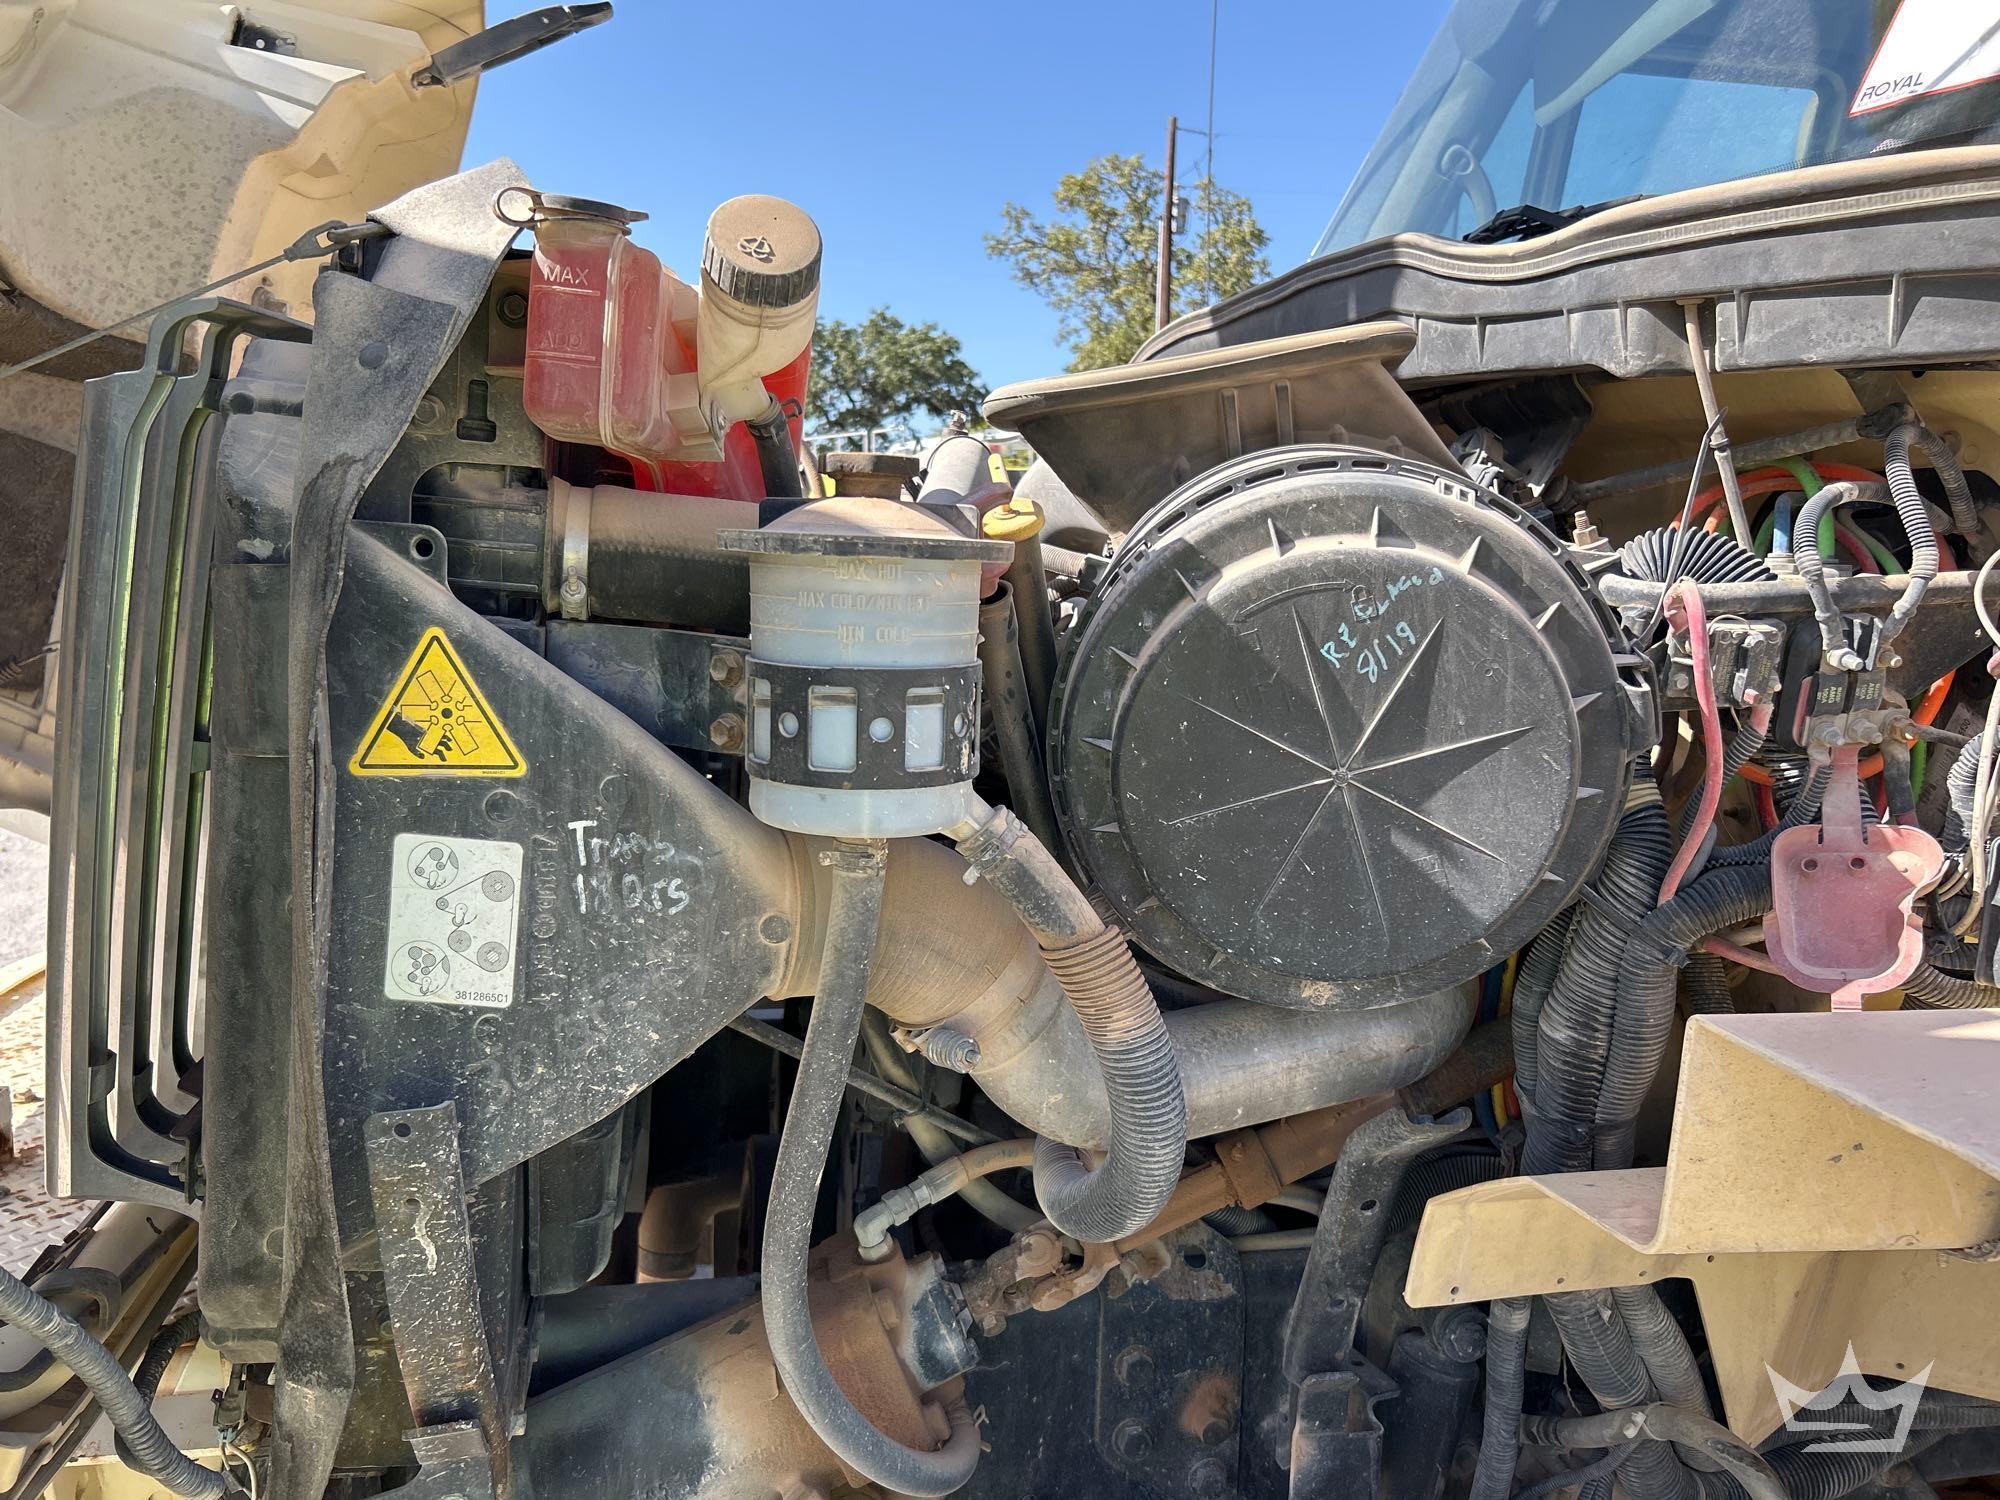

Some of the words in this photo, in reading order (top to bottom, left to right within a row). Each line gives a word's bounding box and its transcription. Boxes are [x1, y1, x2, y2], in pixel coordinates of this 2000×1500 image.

[1860, 72, 1924, 101] ROYAL
[543, 264, 589, 285] MAX
[835, 563, 867, 581] MAX
[877, 564, 905, 580] HOT
[799, 592, 825, 609] MAX
[837, 624, 864, 643] MIN
[876, 625, 913, 643] COLD
[455, 990, 508, 1003] 3812865C1
